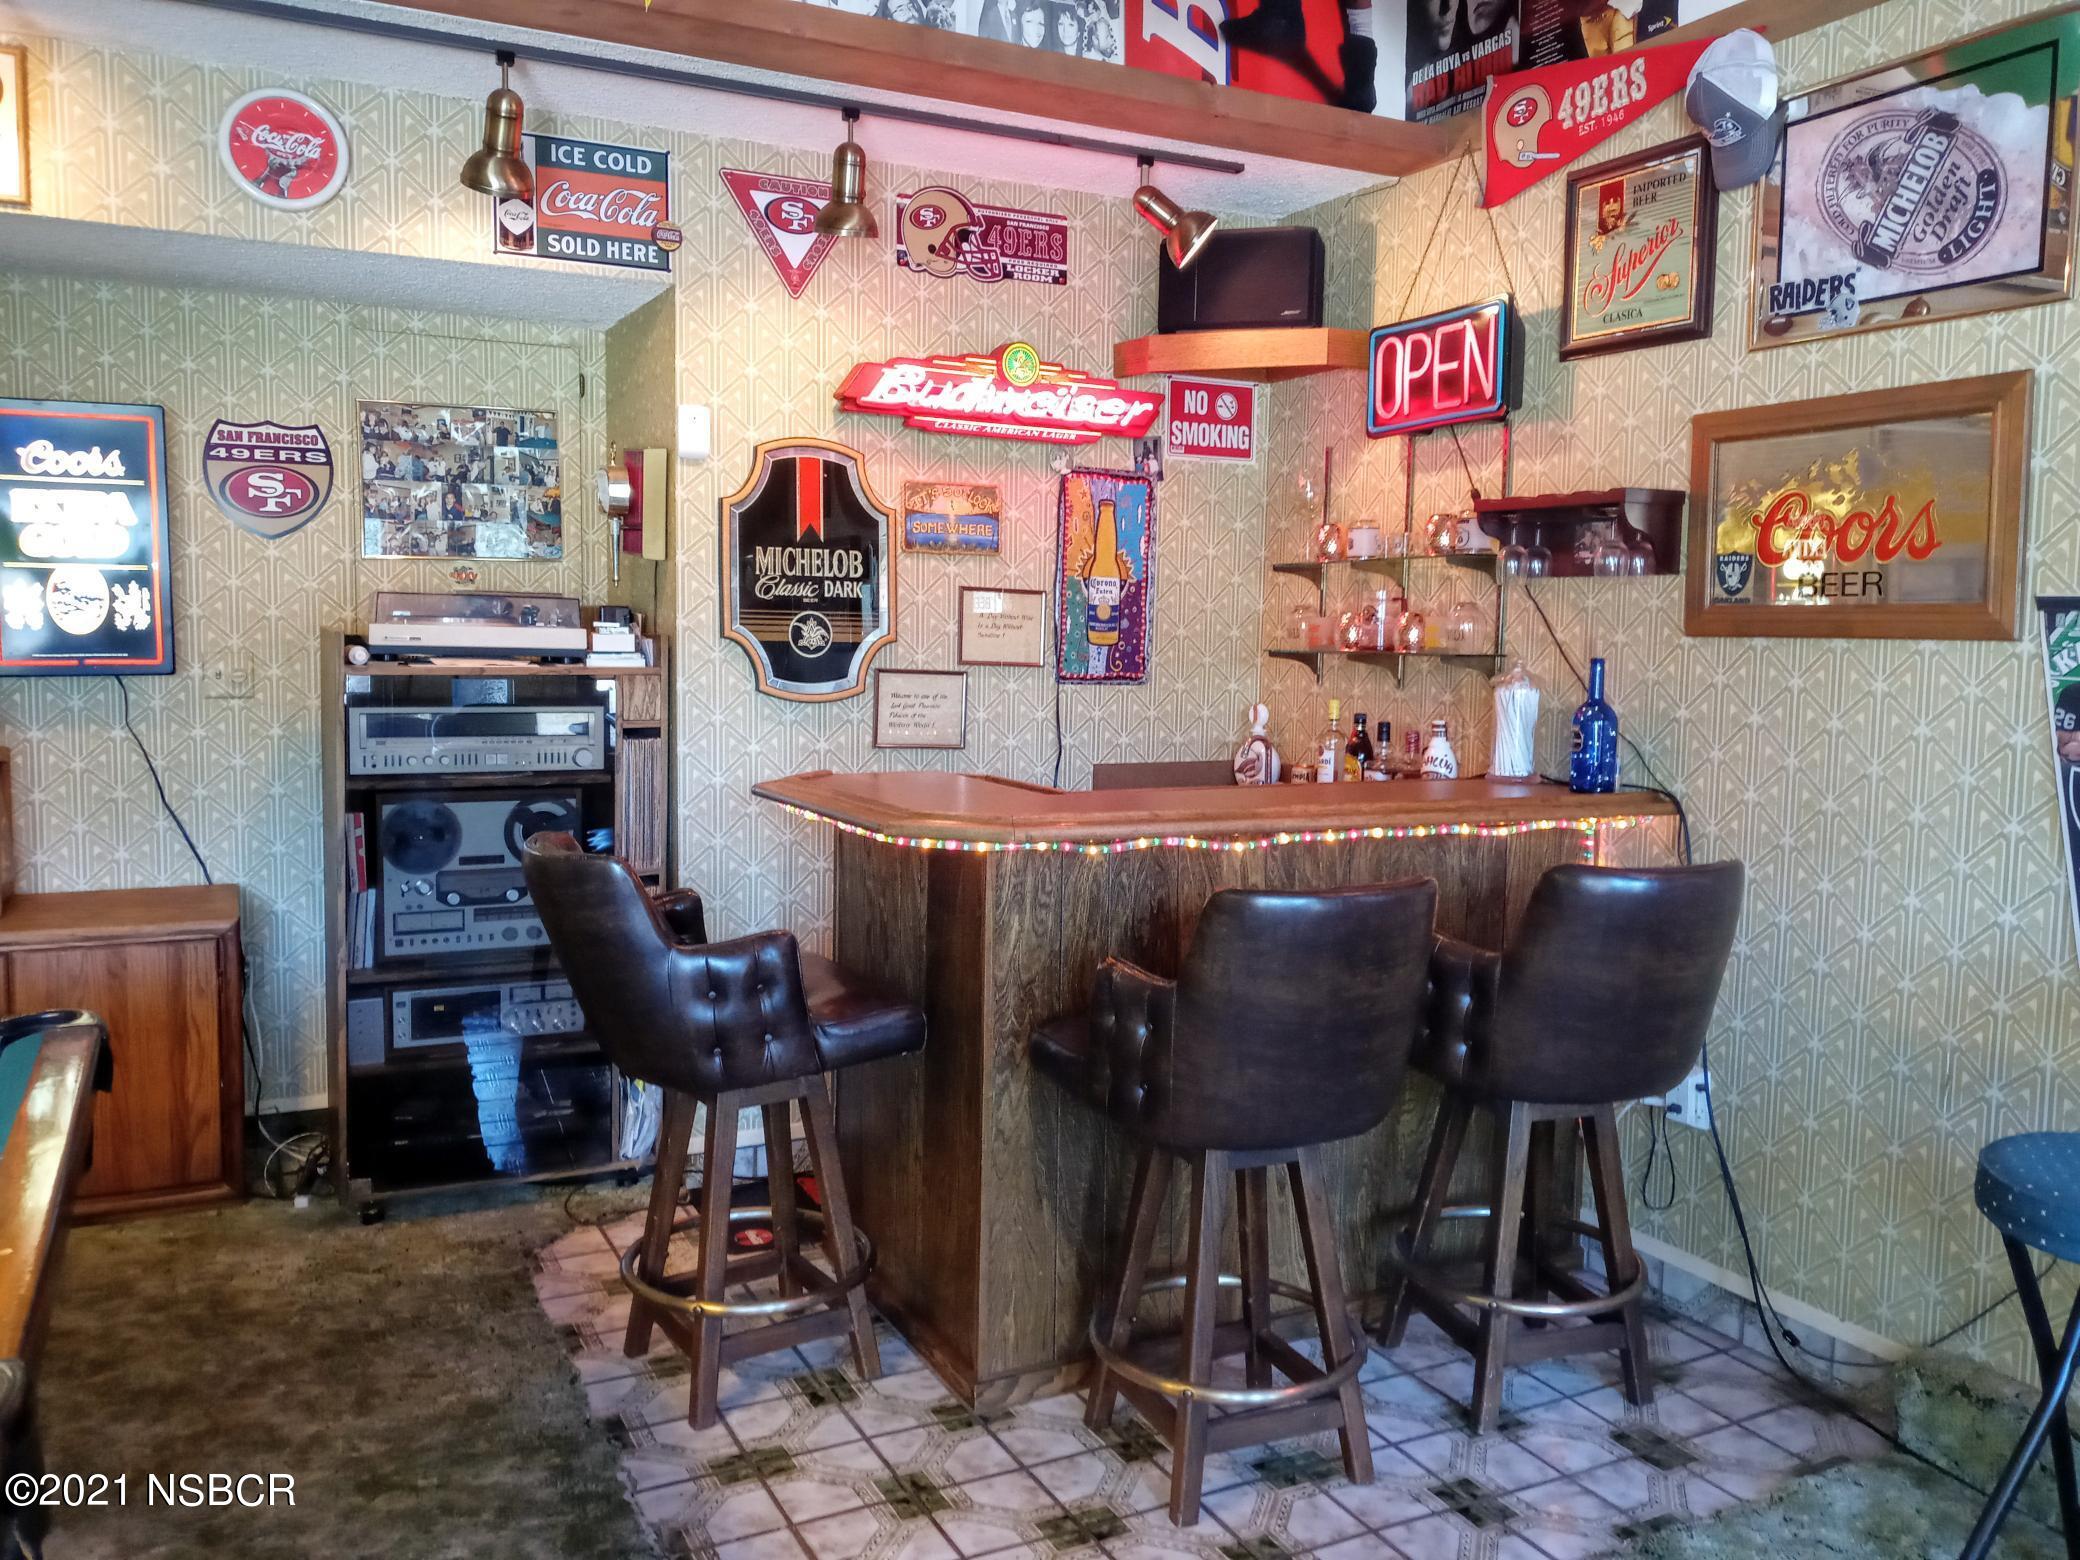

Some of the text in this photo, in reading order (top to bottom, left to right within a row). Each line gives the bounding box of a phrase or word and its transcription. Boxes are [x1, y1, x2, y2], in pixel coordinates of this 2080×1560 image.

[1647, 19, 1665, 32] Sprint
[1412, 70, 1423, 87] DE
[1424, 63, 1434, 80] LA
[1436, 52, 1461, 76] HOYA
[1471, 29, 1512, 60] VARGAS
[1557, 56, 1648, 130] 49ERS
[1578, 109, 1625, 136] EST. 1946
[1842, 129, 1866, 151] FOR
[1866, 119, 1911, 134] PURITY
[251, 124, 326, 159] Coca-Cola
[550, 143, 652, 175] ICE COLD
[758, 178, 830, 198] CAUTION
[1632, 172, 1687, 195] IMPORTED
[1872, 130, 1950, 254] MICHELOB
[540, 180, 662, 228] Coca-Cola
[1632, 194, 1658, 208] BEER
[1912, 161, 1961, 243] Golden
[1930, 176, 1972, 243] Draft
[1019, 221, 1050, 231] FRANCISCO
[1949, 181, 1997, 260] LIGHT
[547, 235, 659, 264] SOLD HERE
[987, 225, 1064, 261] 49ERS
[1006, 264, 1060, 277] LOCKER
[1013, 272, 1054, 283] ROOM
[1583, 217, 1684, 318] Superior
[1768, 272, 1858, 314] RAIDERS
[1602, 308, 1643, 325] CLASICA
[1375, 313, 1496, 420] OPEN
[856, 364, 1153, 426] Budweiser
[1184, 389, 1209, 416] NO
[217, 429, 319, 447] SAN FRANCISCO
[934, 420, 1078, 441] CLASSIC AMERICAN LAGER
[1171, 420, 1250, 450] SMOKING
[209, 446, 328, 464] 49ERS
[912, 520, 994, 537] SOMEWHERE
[1751, 490, 1944, 568] Coors
[755, 545, 864, 579] MICHELOB
[754, 574, 863, 600] Classic DARK
[1090, 577, 1117, 589] Corona
[1798, 571, 1884, 598] BEER
